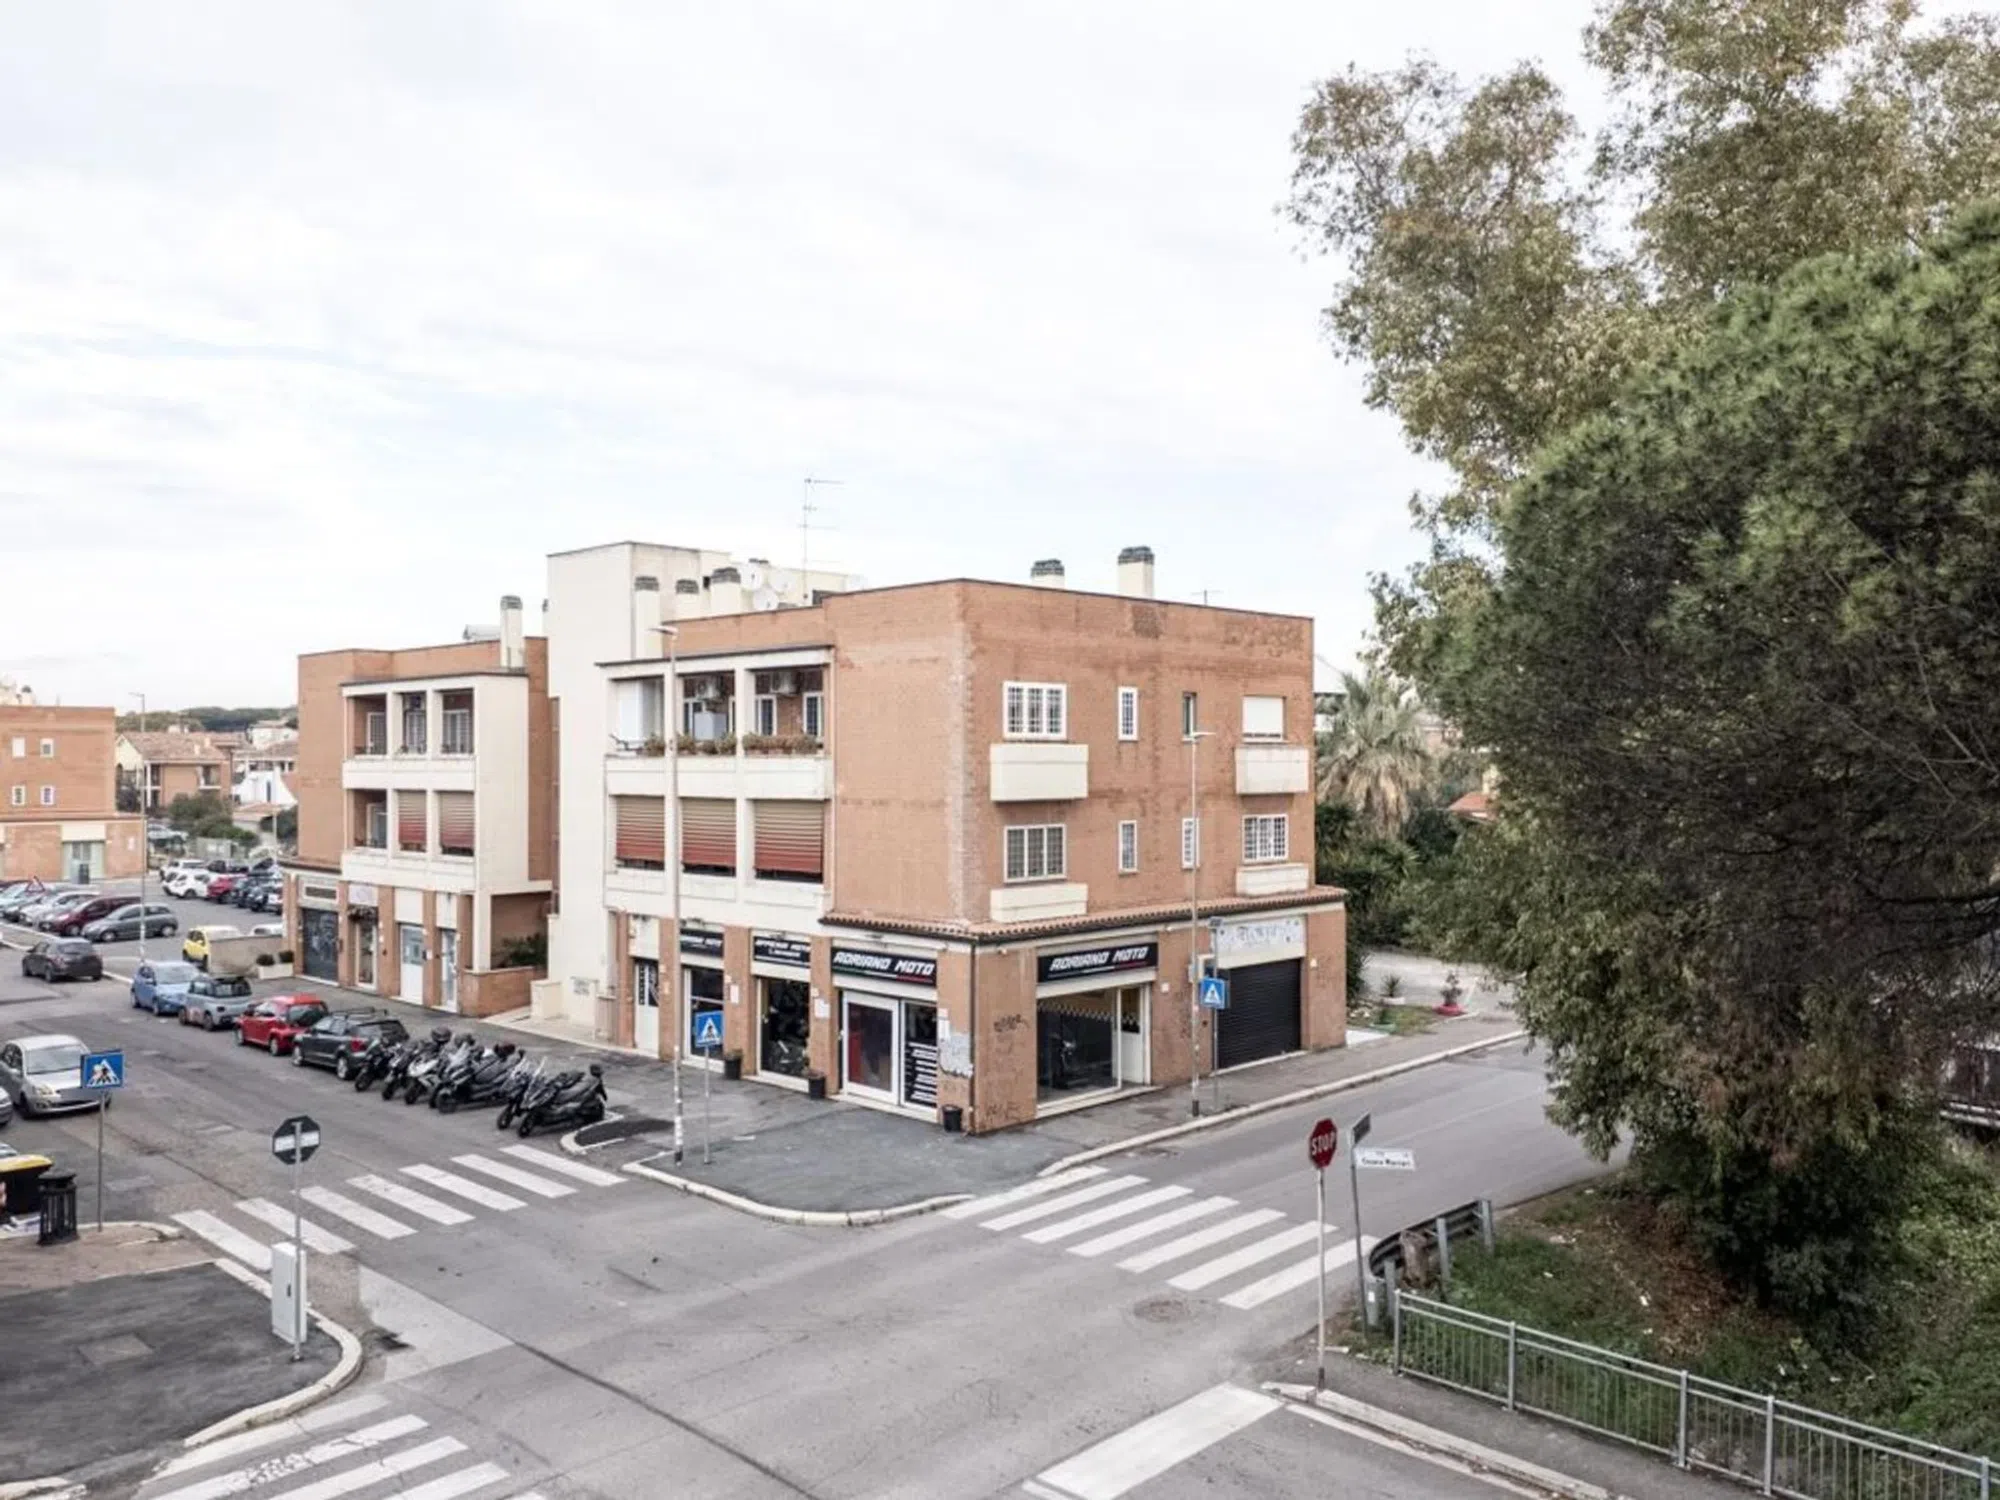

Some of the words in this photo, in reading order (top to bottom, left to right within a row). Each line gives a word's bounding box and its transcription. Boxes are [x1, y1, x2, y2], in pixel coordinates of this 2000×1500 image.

[833, 951, 892, 970] ADRIANO
[894, 960, 935, 976] MOTO
[1049, 951, 1111, 972] ADRIANO
[1112, 946, 1149, 963] MOTO
[1311, 1131, 1336, 1156] STOP
